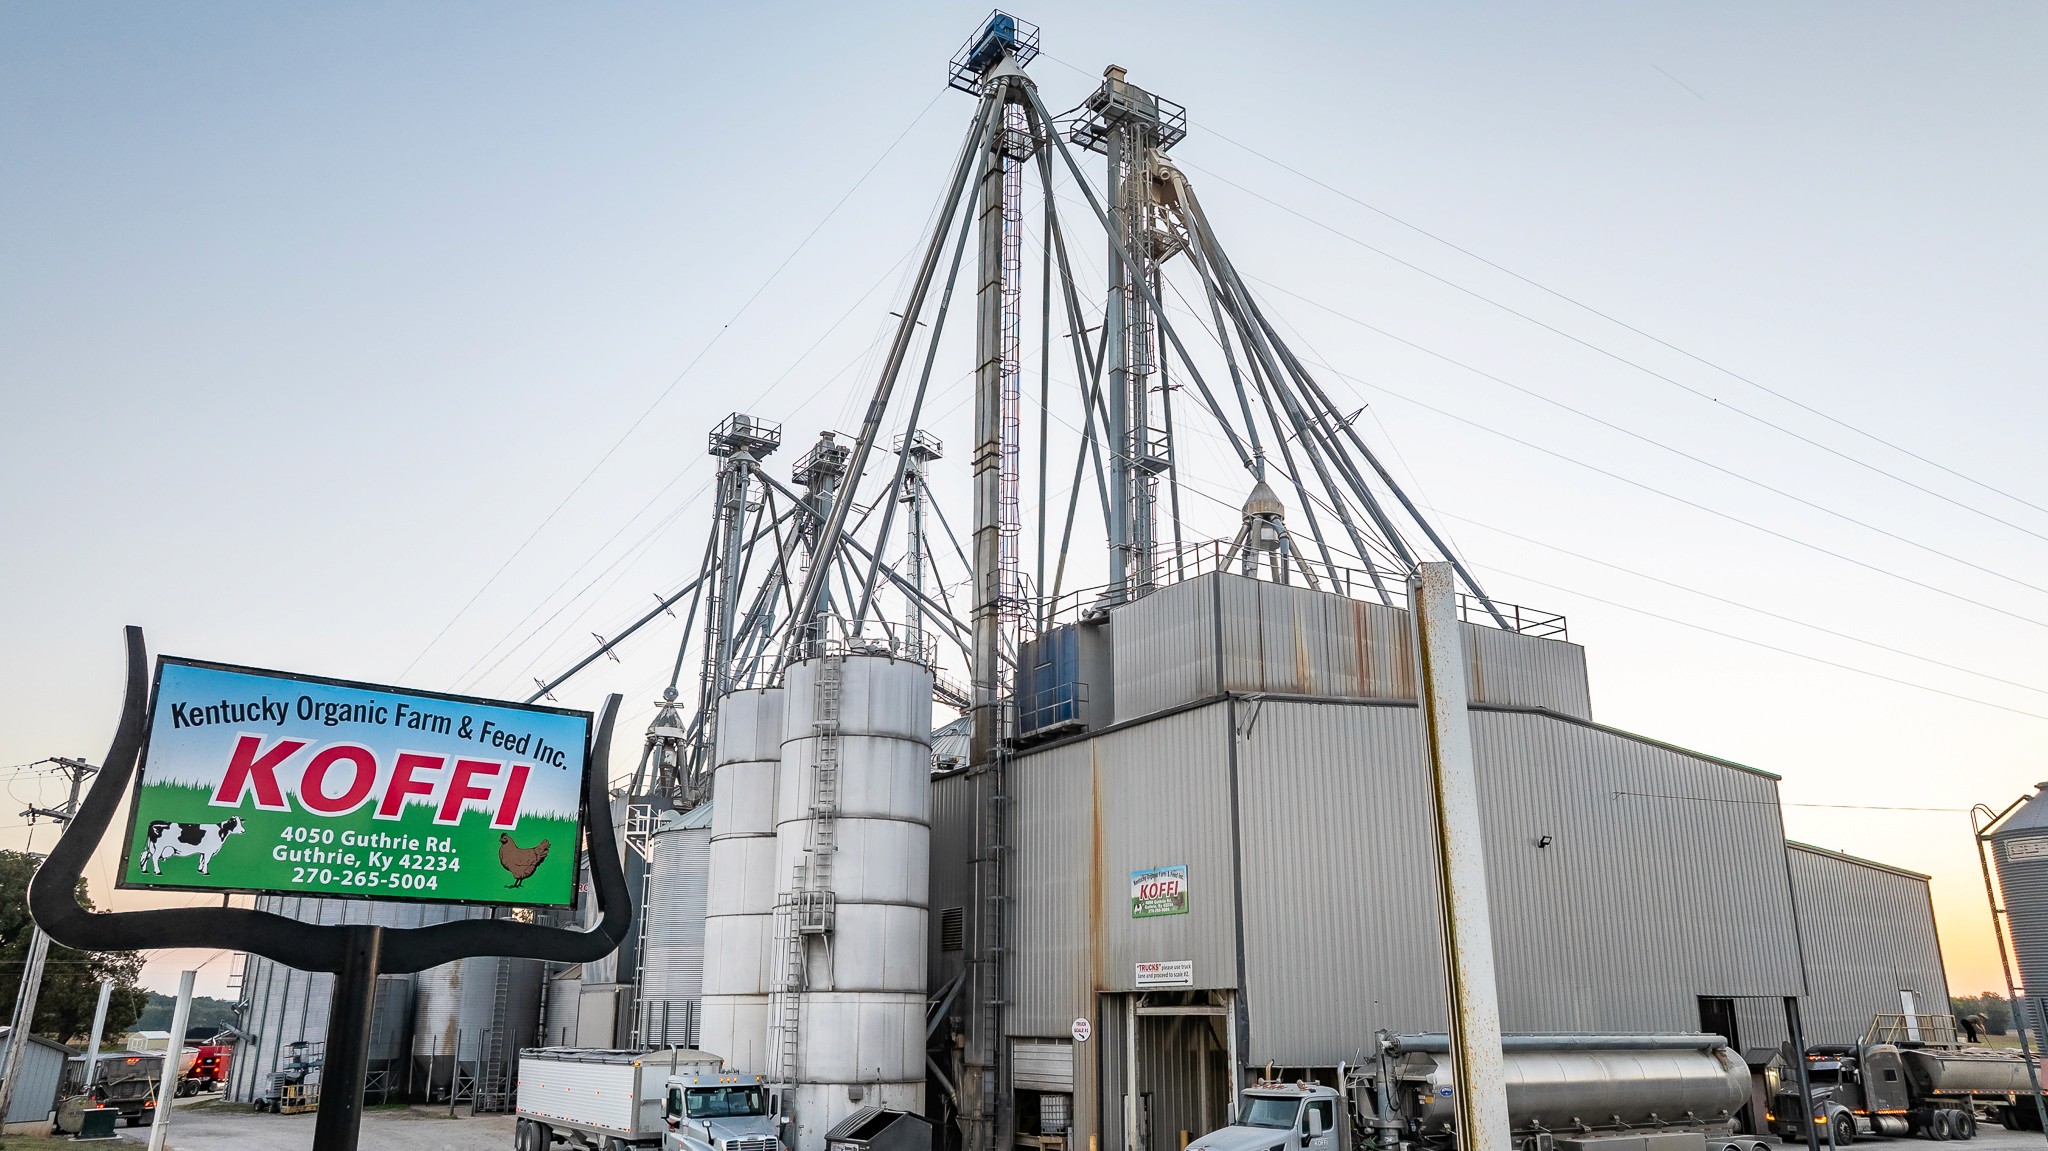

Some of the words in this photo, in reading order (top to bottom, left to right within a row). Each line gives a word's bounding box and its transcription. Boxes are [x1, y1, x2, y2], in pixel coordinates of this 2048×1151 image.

[171, 696, 289, 729] Kentucky
[297, 696, 388, 726] Organic
[395, 703, 450, 734] Farm
[457, 715, 473, 740] &
[479, 720, 532, 756] Feed
[533, 738, 568, 770] Inc.
[208, 731, 536, 830] KOFFI
[281, 826, 334, 845] 4050
[341, 830, 420, 851] Guthrie
[426, 837, 457, 853] Rd.
[272, 845, 361, 868] Guthrie,
[369, 851, 393, 871] Ky
[399, 854, 460, 872] 42234
[292, 867, 438, 890] 270-265-5004
[1139, 880, 1179, 900] KOFFI
[1137, 963, 1161, 971] "TRUCKS"
[1154, 971, 1168, 979] proceed
